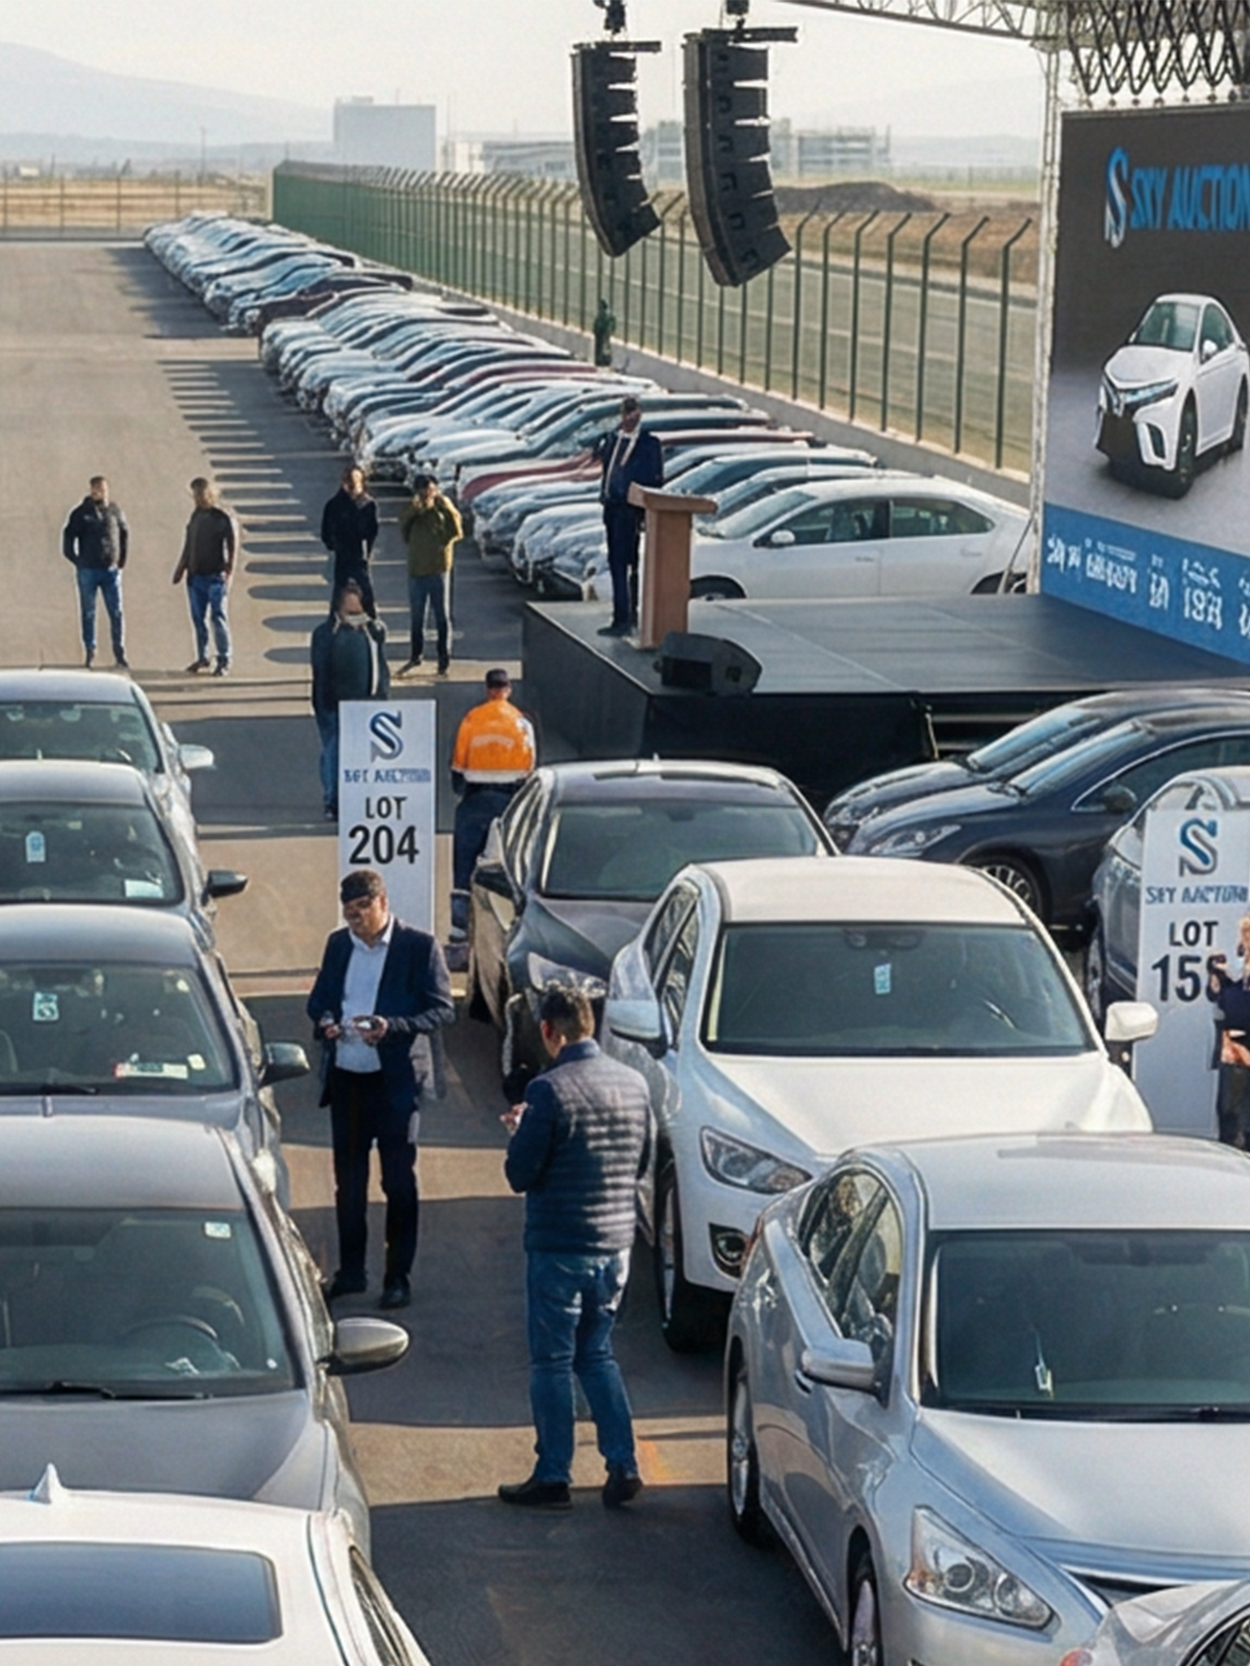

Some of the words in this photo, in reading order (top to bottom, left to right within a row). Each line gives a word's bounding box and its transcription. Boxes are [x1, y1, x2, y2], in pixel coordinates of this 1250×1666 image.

[366, 796, 407, 820] LOT
[348, 824, 419, 864] 204
[1170, 921, 1219, 947] LOT
